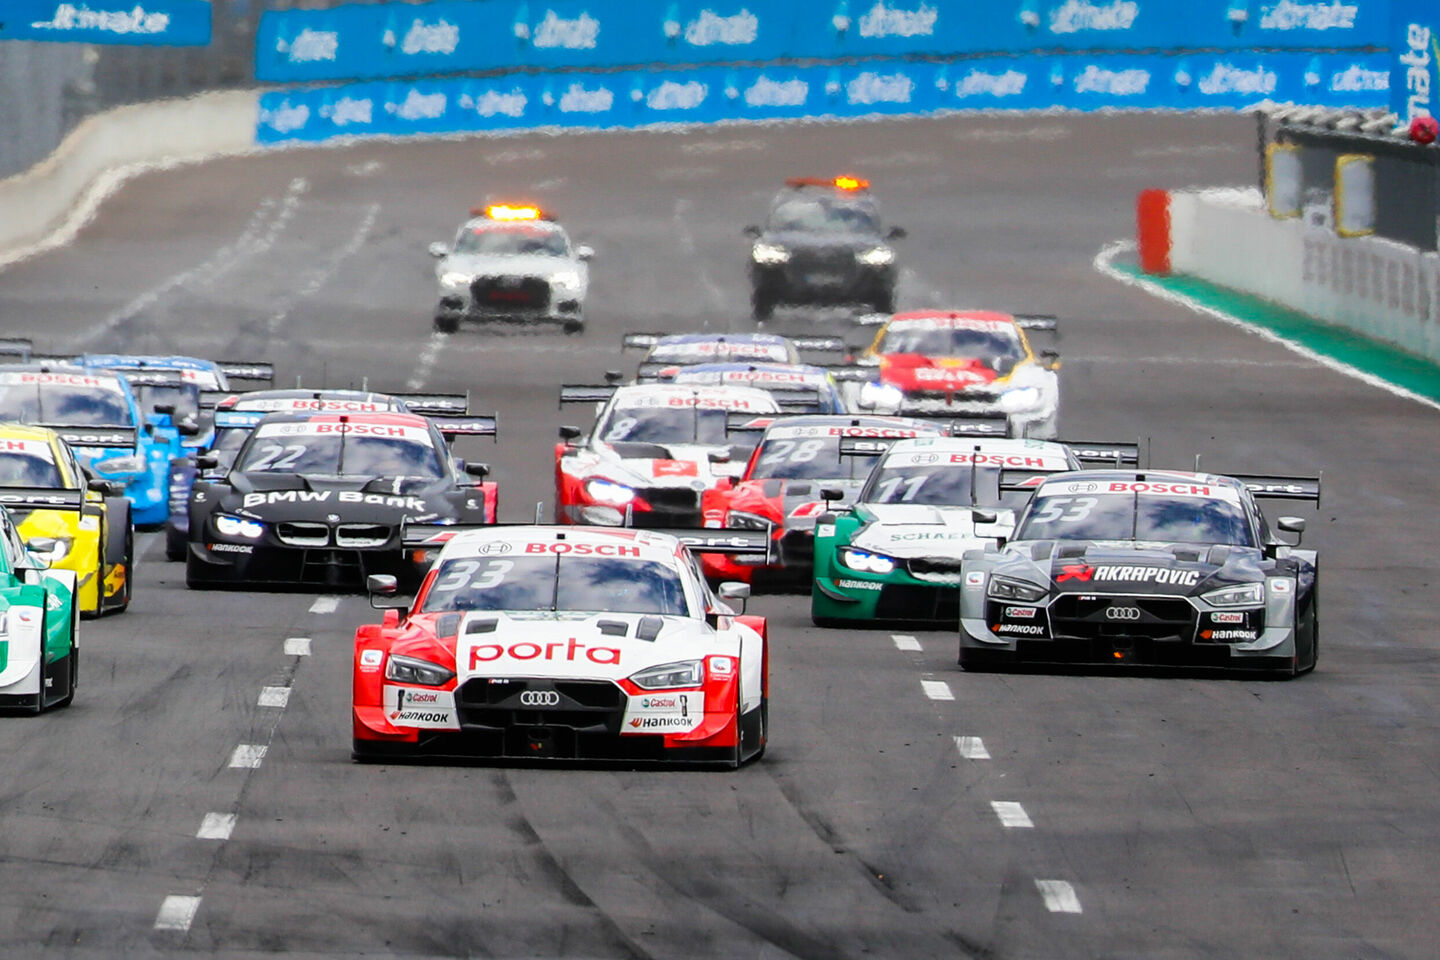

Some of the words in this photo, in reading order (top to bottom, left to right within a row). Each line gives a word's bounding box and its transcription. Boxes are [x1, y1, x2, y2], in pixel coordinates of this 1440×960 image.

[21, 374, 100, 386] BOSCH
[729, 373, 804, 382] BOSCH
[293, 400, 376, 412] BOSCH
[668, 398, 749, 409] BOSCH
[317, 424, 405, 436] BOSCH
[829, 428, 916, 437] BOSCH
[248, 446, 307, 471] 22
[762, 439, 825, 465] 28
[950, 454, 1043, 468] BOSCH
[877, 475, 929, 503] 11
[1109, 482, 1210, 496] BOSCH
[243, 490, 332, 508] BMW
[339, 492, 426, 512] Bank
[1031, 498, 1098, 523] 53
[525, 543, 641, 557] BOSCH
[438, 560, 515, 591] 33
[1219, 614, 1241, 622] Castrol
[469, 638, 621, 670] porta
[412, 693, 438, 702] Castrol
[650, 698, 675, 707] Castrol
